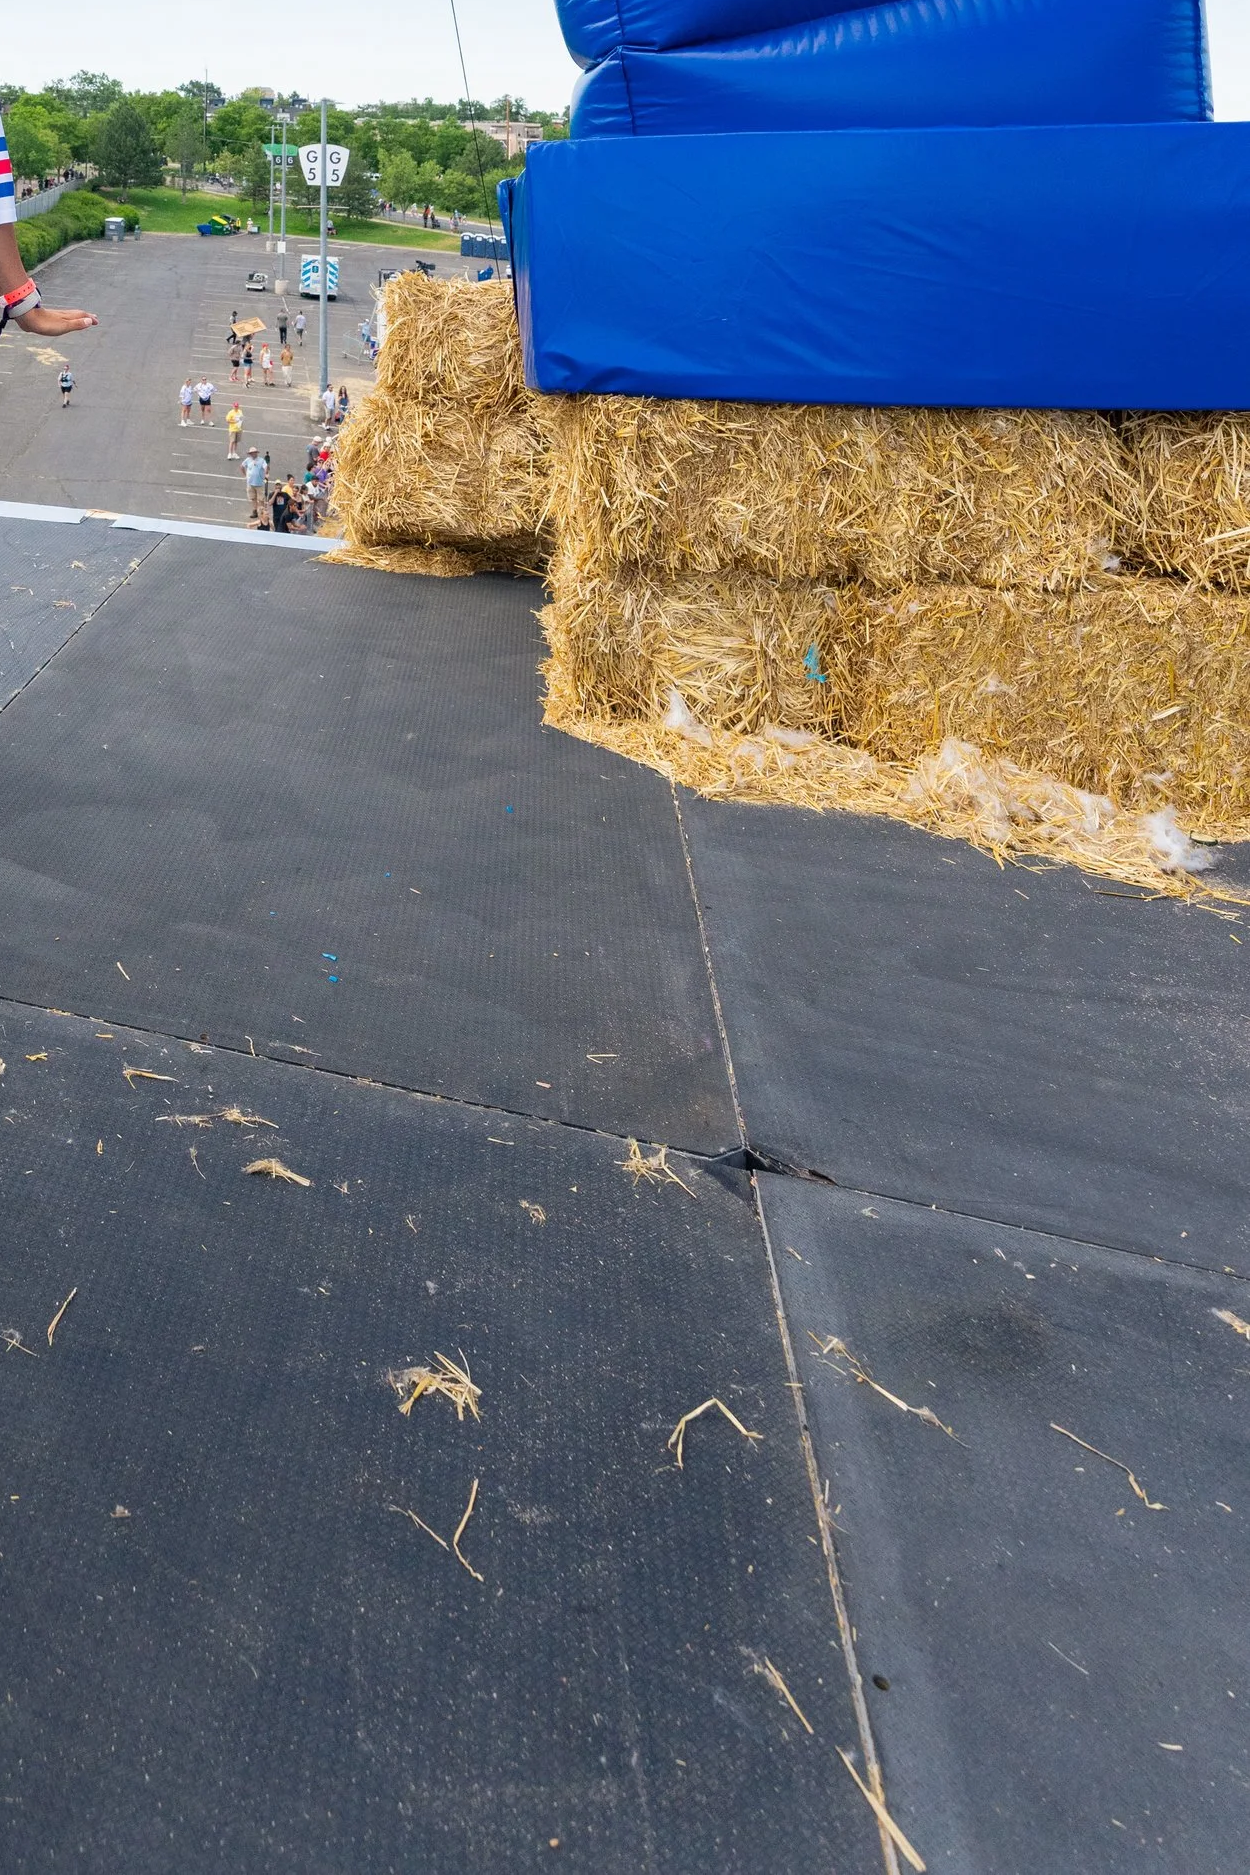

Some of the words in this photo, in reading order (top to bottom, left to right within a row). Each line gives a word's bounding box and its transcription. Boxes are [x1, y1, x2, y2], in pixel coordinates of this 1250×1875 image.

[275, 156, 281, 164] 6
[288, 156, 294, 164] 6
[307, 150, 318, 163] G
[330, 152, 341, 164] G
[308, 168, 316, 181] 5
[331, 169, 339, 182] 5
